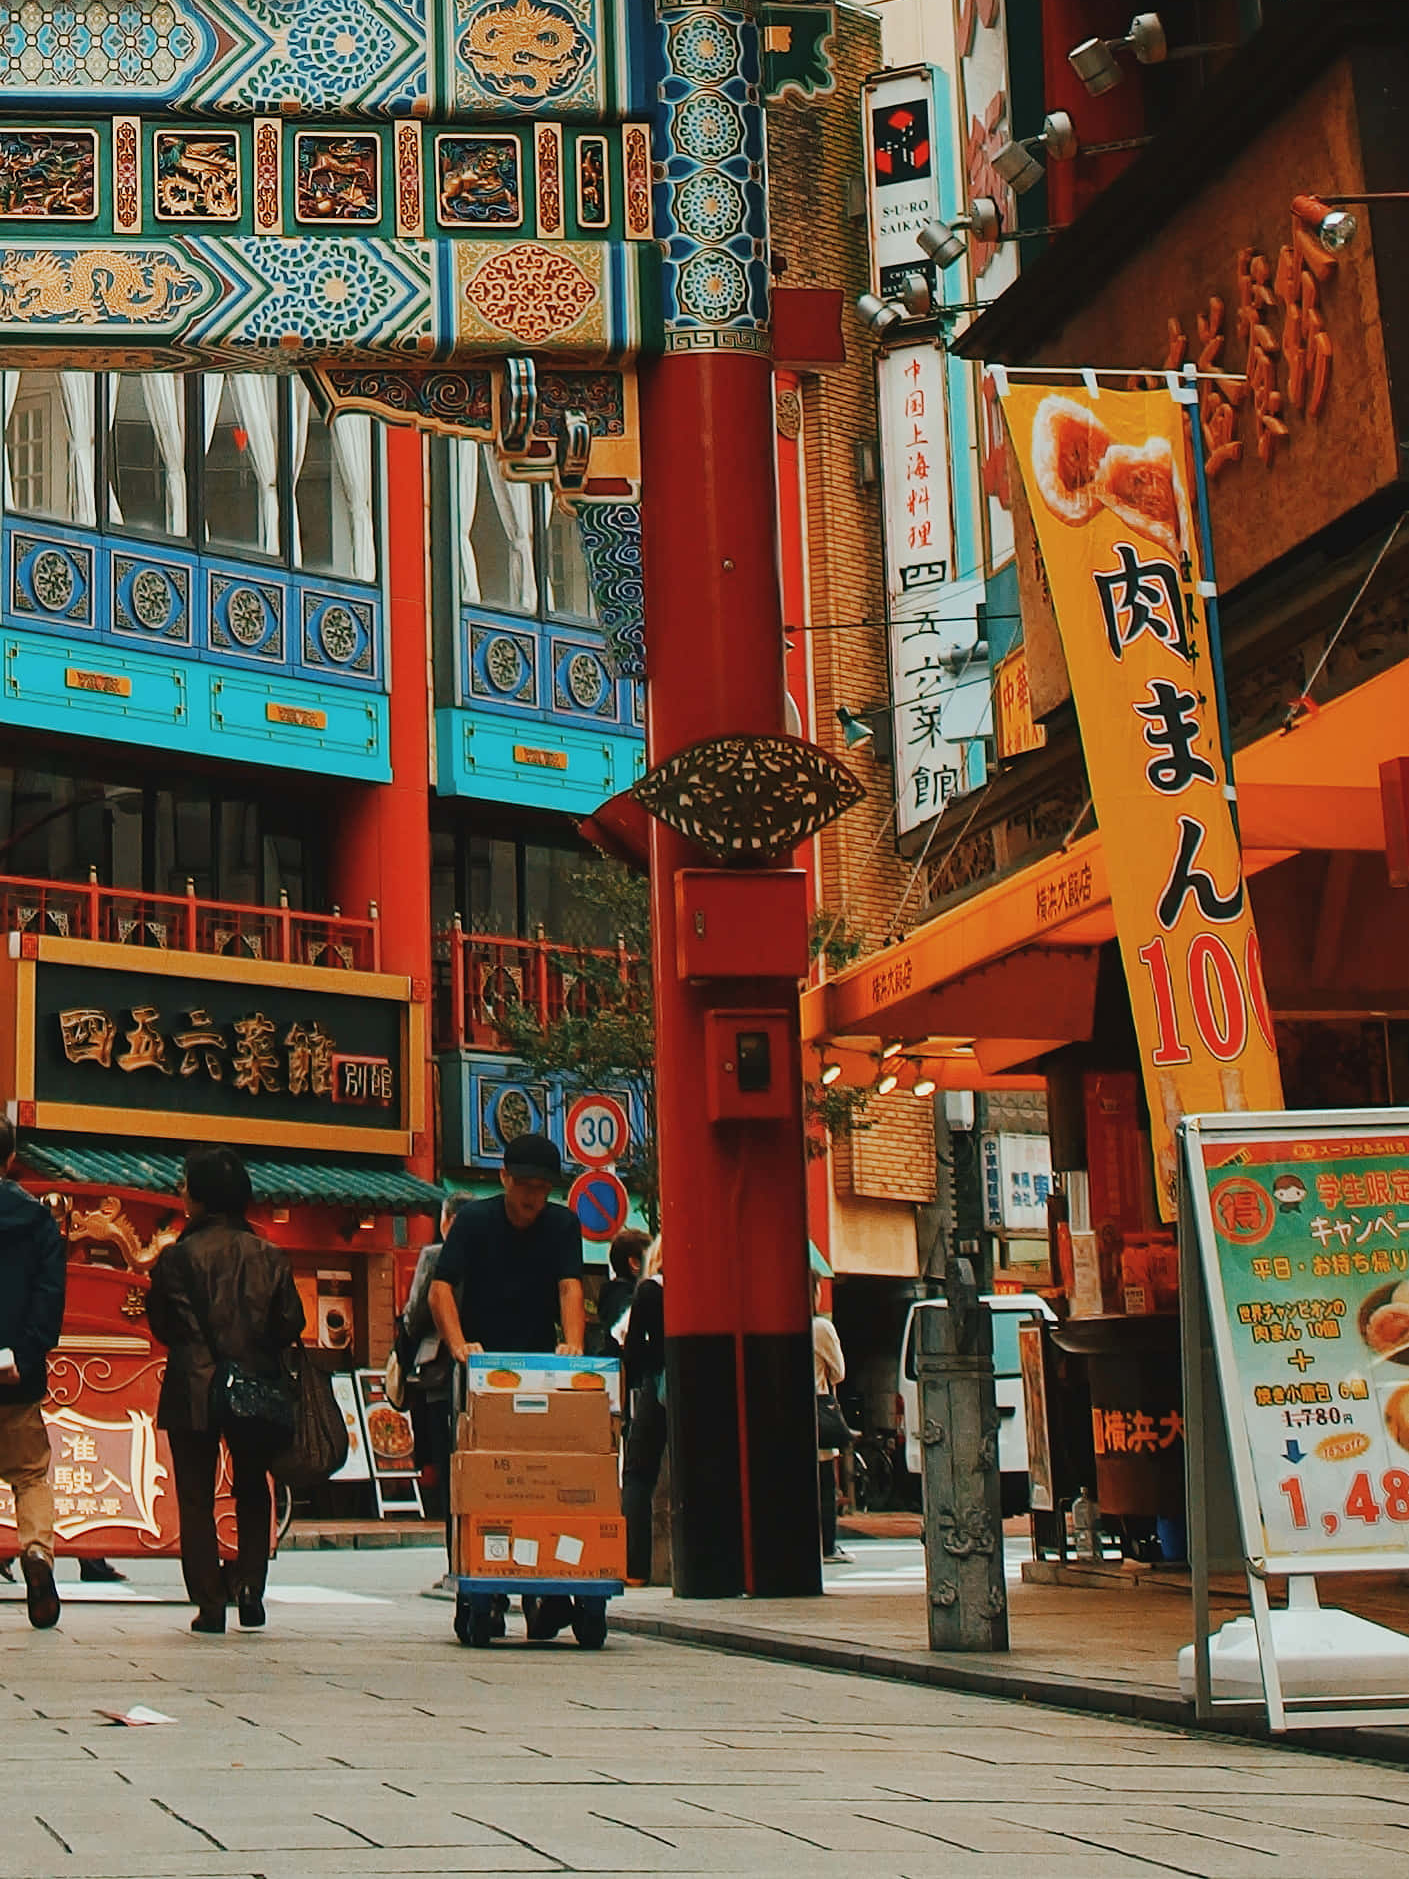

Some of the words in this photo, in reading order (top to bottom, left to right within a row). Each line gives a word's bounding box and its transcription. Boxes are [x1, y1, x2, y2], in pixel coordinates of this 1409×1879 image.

[904, 358, 933, 550] 中国上海料理
[899, 560, 959, 810] 四五六菜館
[1095, 540, 1244, 929] 肉まん
[580, 1116, 615, 1147] 30
[1253, 1323, 1302, 1343] 肉まん
